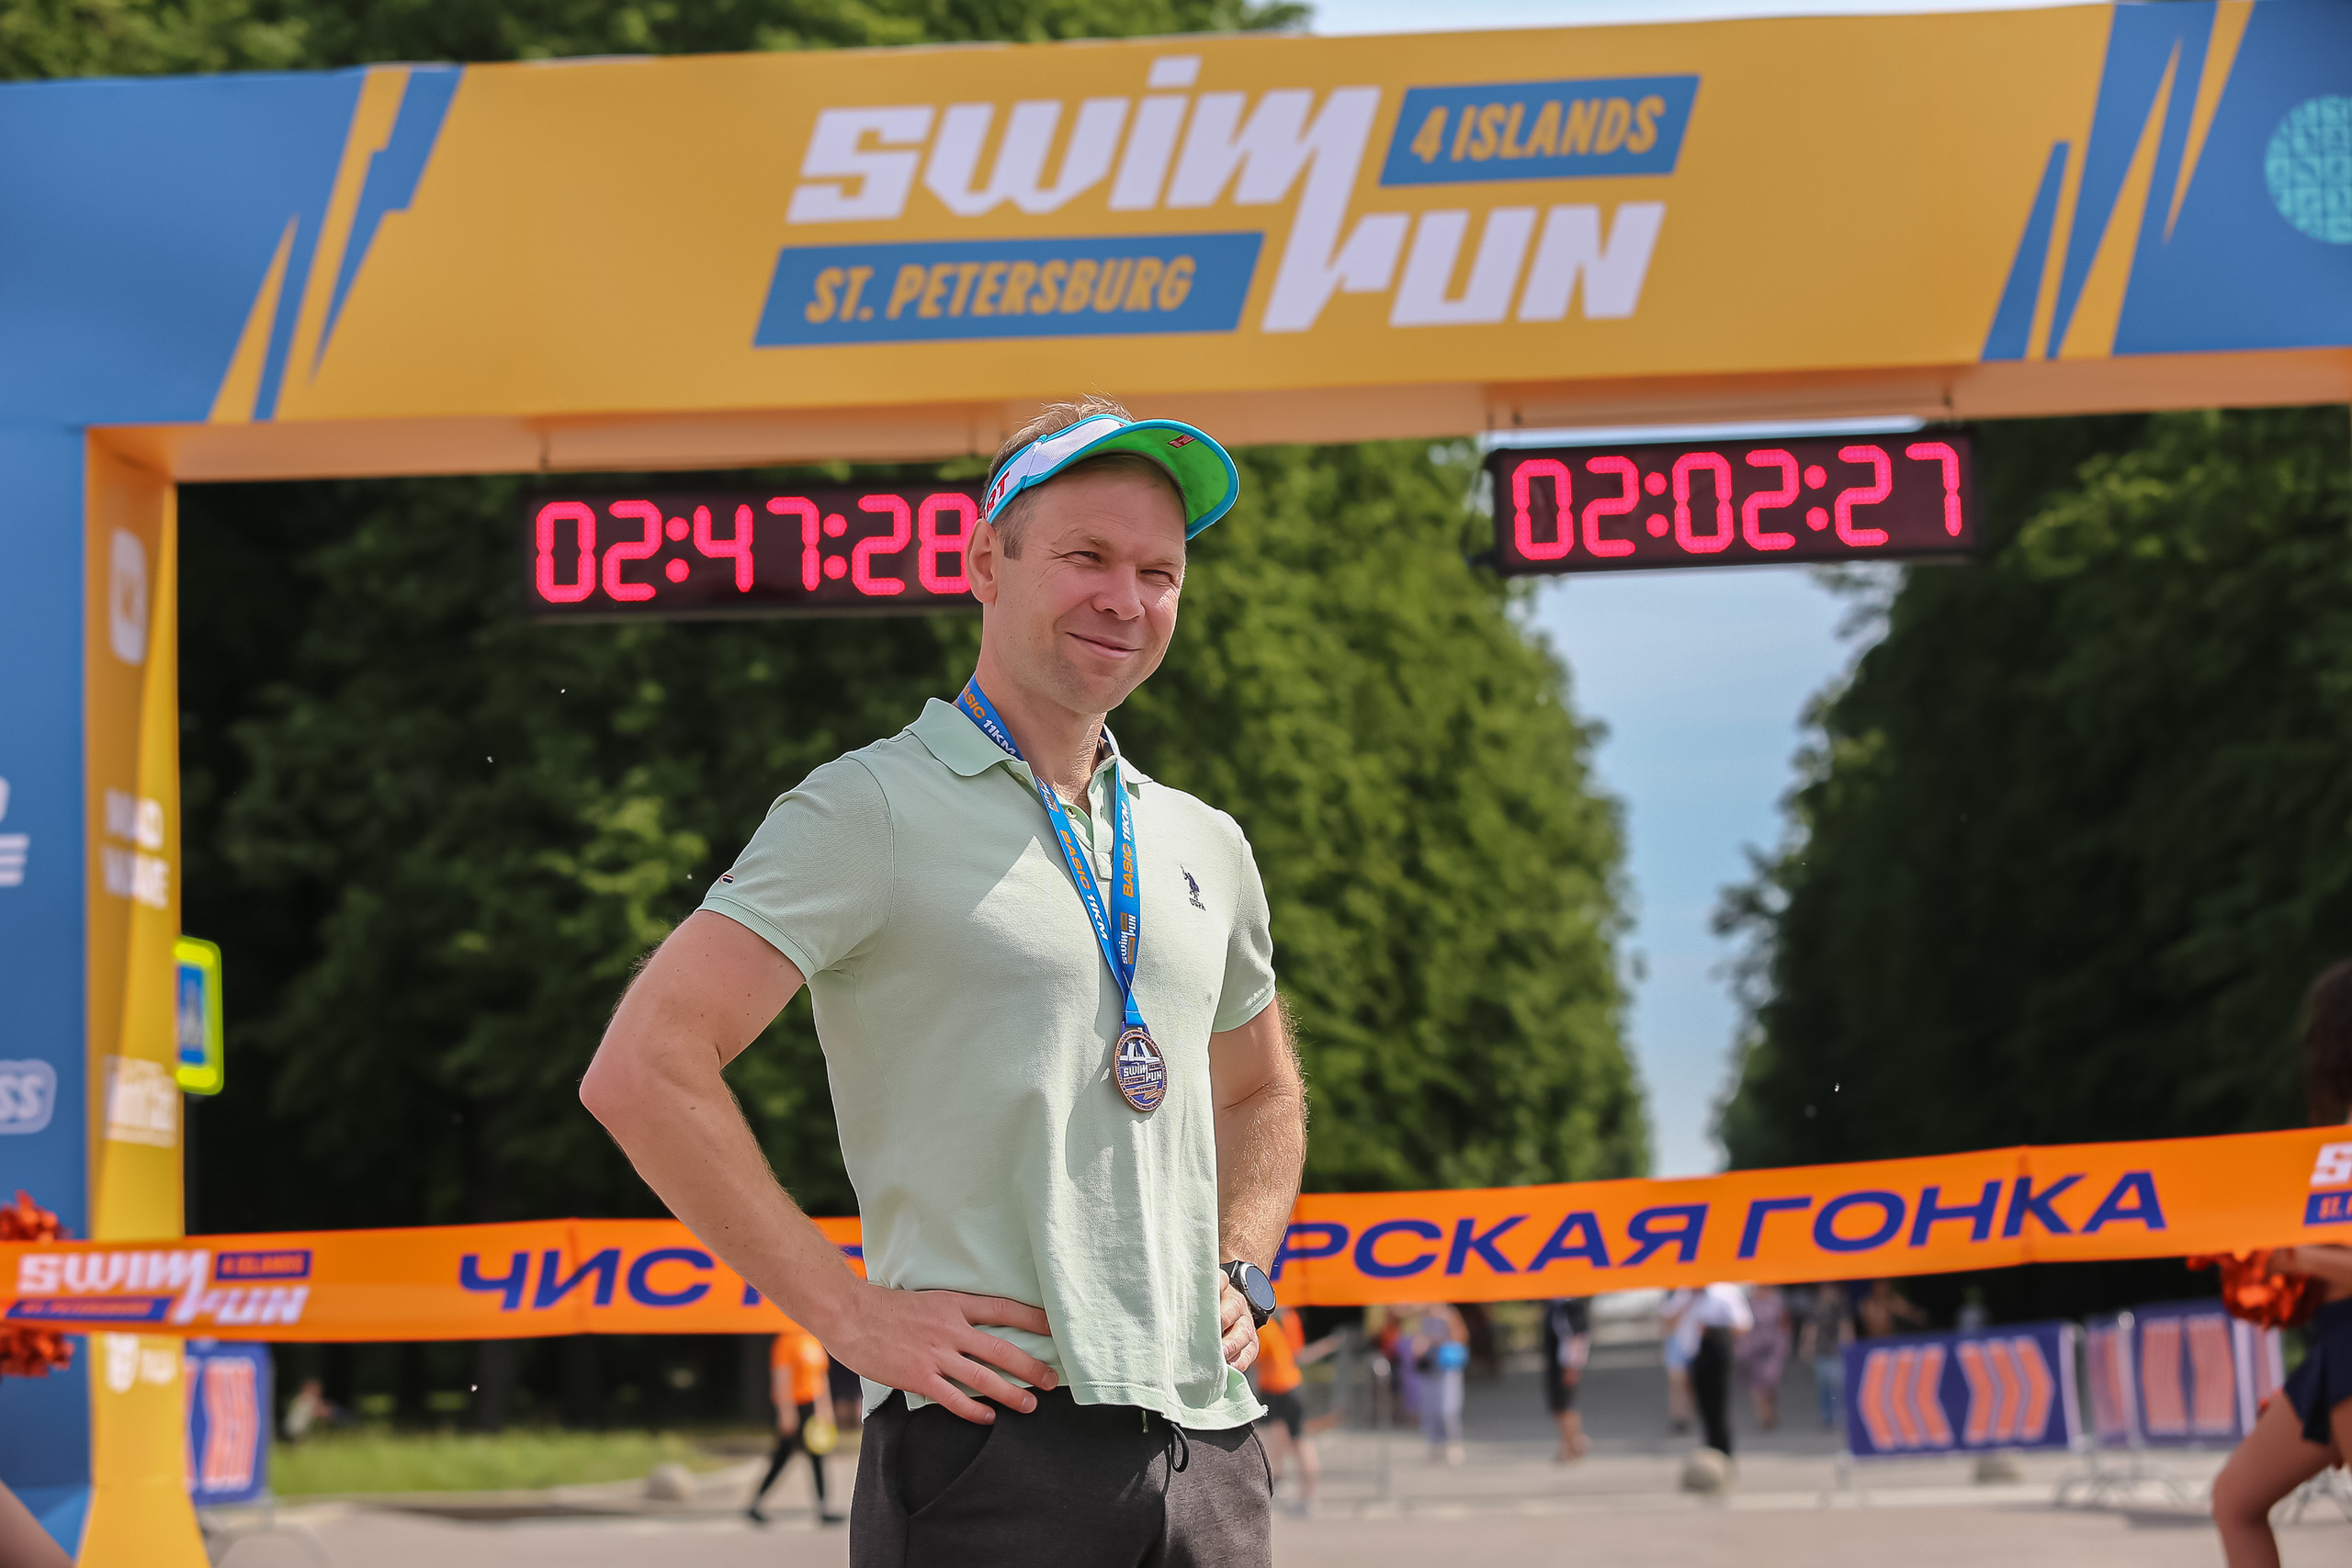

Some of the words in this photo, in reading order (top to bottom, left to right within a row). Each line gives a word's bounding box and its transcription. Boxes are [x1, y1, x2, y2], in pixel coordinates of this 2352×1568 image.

[1409, 105, 1450, 164] 4
[1451, 95, 1667, 163] ISLANDS
[805, 265, 874, 323] ST.
[886, 255, 1196, 320] PETERSBURG
[1512, 442, 1962, 560] 02:02:27
[536, 492, 979, 603] 02:47:28
[963, 687, 986, 719] ASIC
[983, 718, 1016, 755] 11KM
[1121, 800, 1131, 842] 11KM
[1060, 829, 1091, 890] BASIC
[1087, 894, 1109, 941] 11KM
[1122, 842, 1135, 898] BASIC
[459, 1245, 862, 1312] ЧИС
[1270, 1202, 1711, 1281] РСКАЯ
[1736, 1169, 2167, 1260] ГОНКА
